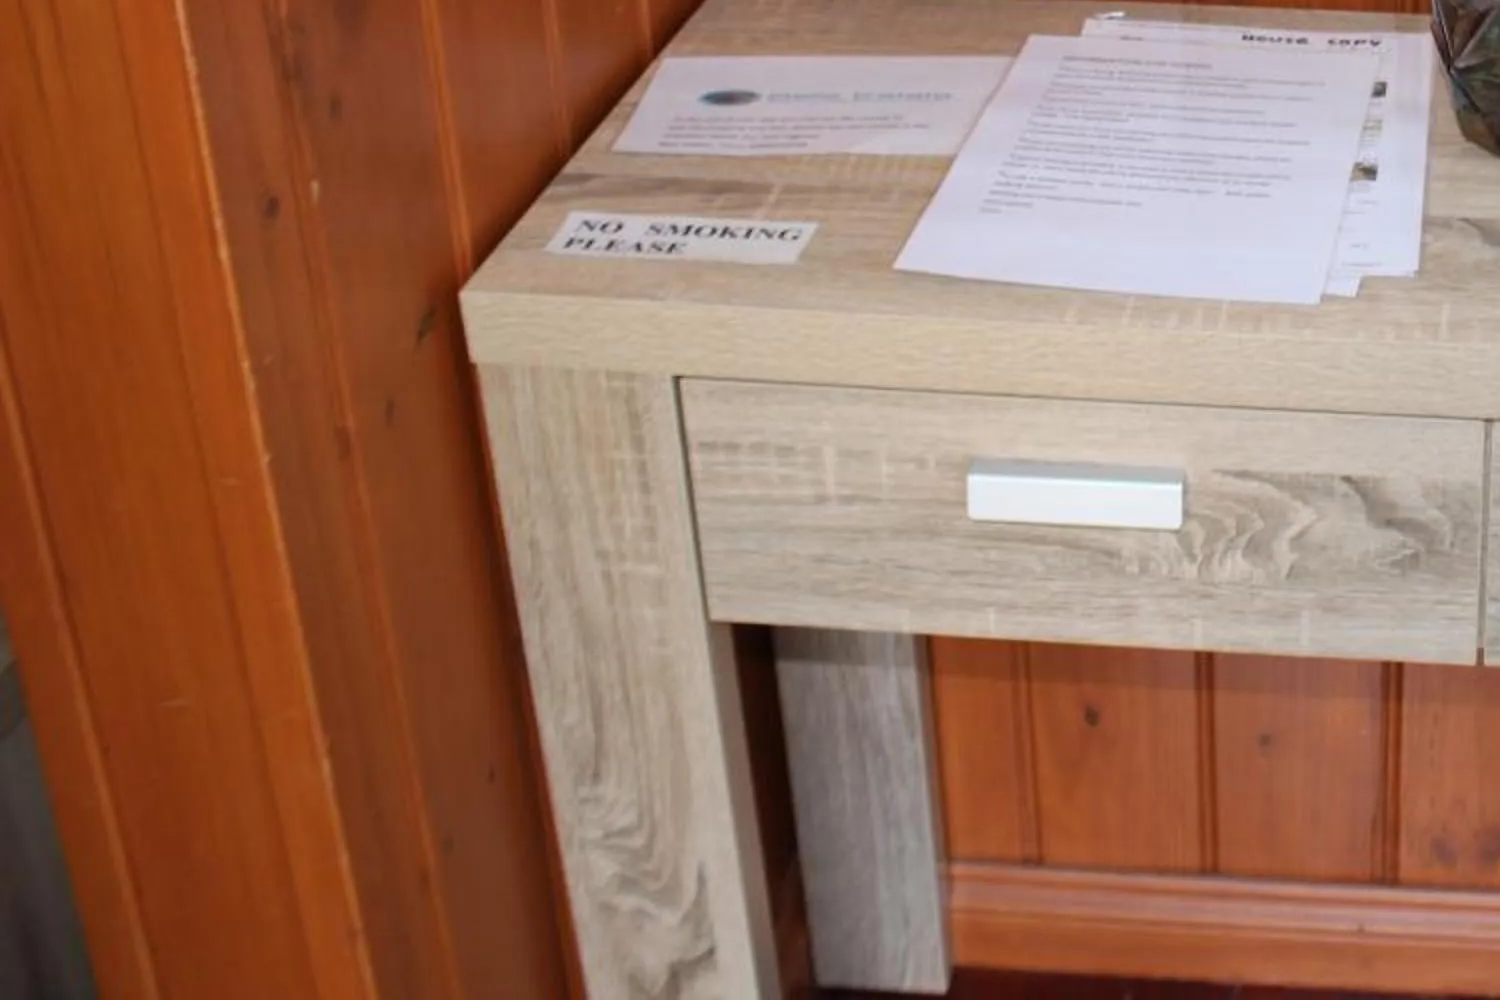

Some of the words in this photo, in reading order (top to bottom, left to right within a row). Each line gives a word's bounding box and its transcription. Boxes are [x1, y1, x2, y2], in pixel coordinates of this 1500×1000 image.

[575, 218, 625, 234] NO
[644, 223, 802, 241] SMOKING
[563, 235, 688, 254] PLEASE
